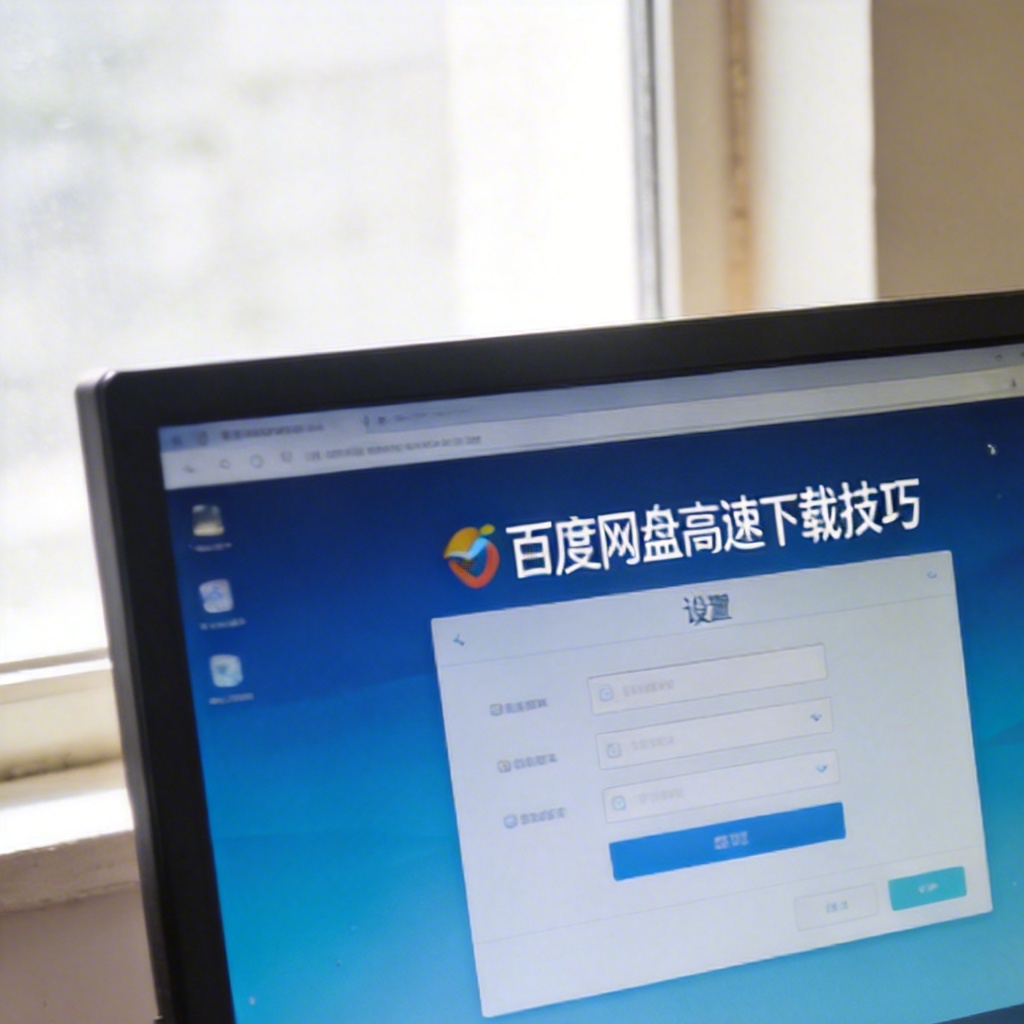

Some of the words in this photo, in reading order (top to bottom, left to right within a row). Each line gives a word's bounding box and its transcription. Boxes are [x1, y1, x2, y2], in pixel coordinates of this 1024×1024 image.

[505, 478, 921, 579] 百度网盘高速下载技巧
[683, 593, 733, 626] 设置
